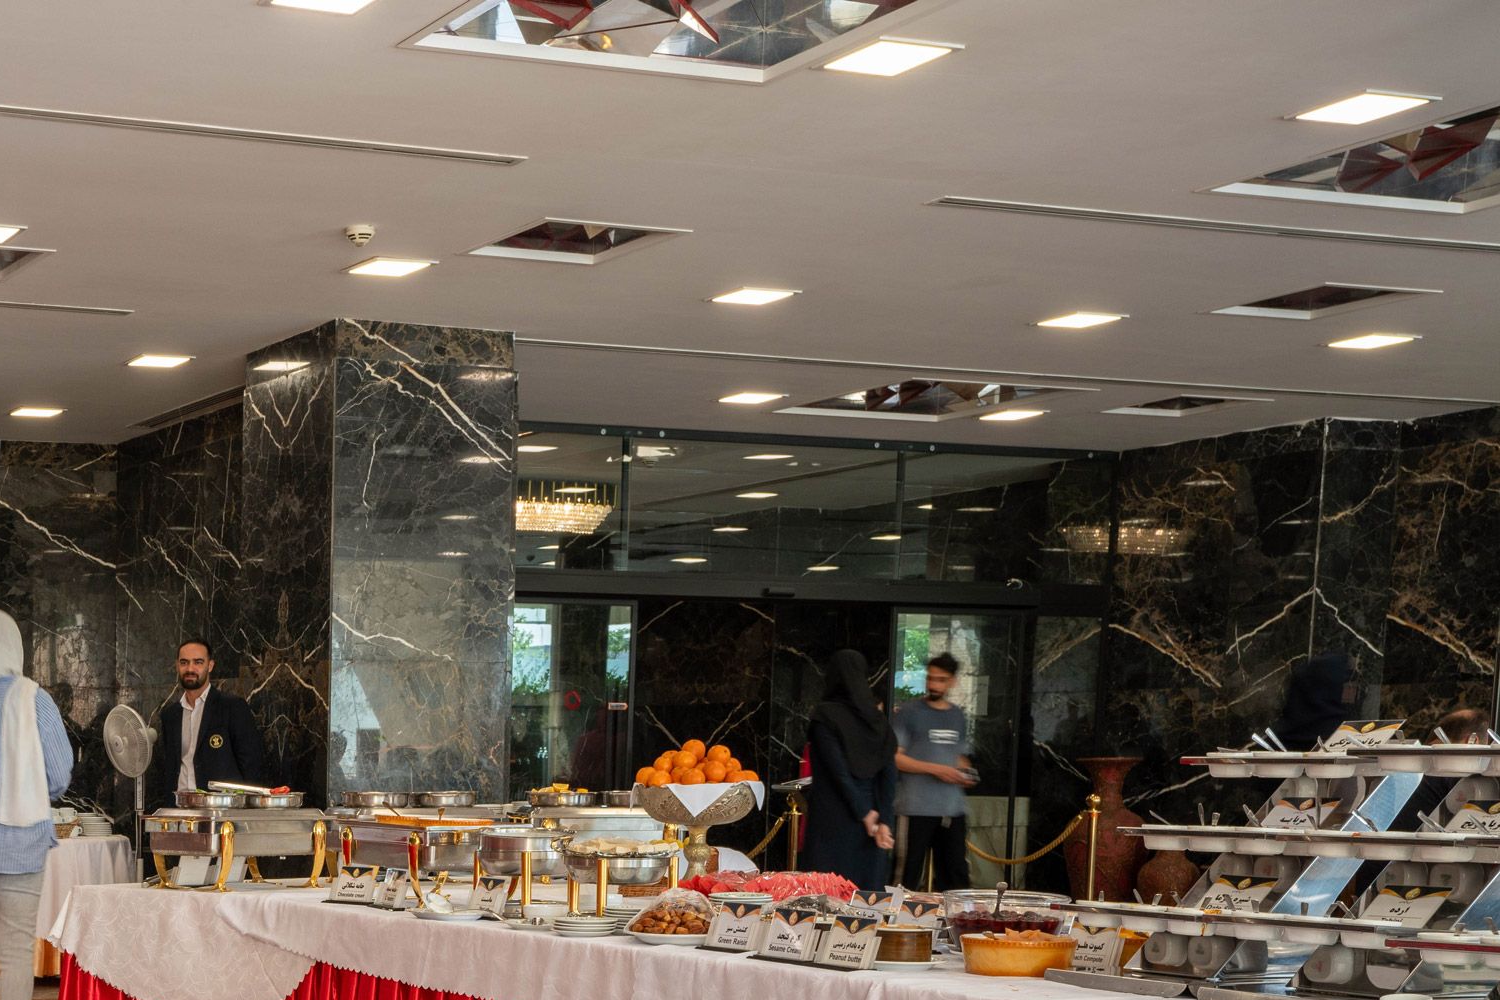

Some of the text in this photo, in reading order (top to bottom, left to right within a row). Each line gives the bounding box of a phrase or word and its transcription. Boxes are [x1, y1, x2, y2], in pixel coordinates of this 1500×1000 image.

[717, 936, 732, 945] Green
[768, 944, 786, 953] Sesame
[829, 952, 863, 963] Peanut butte
